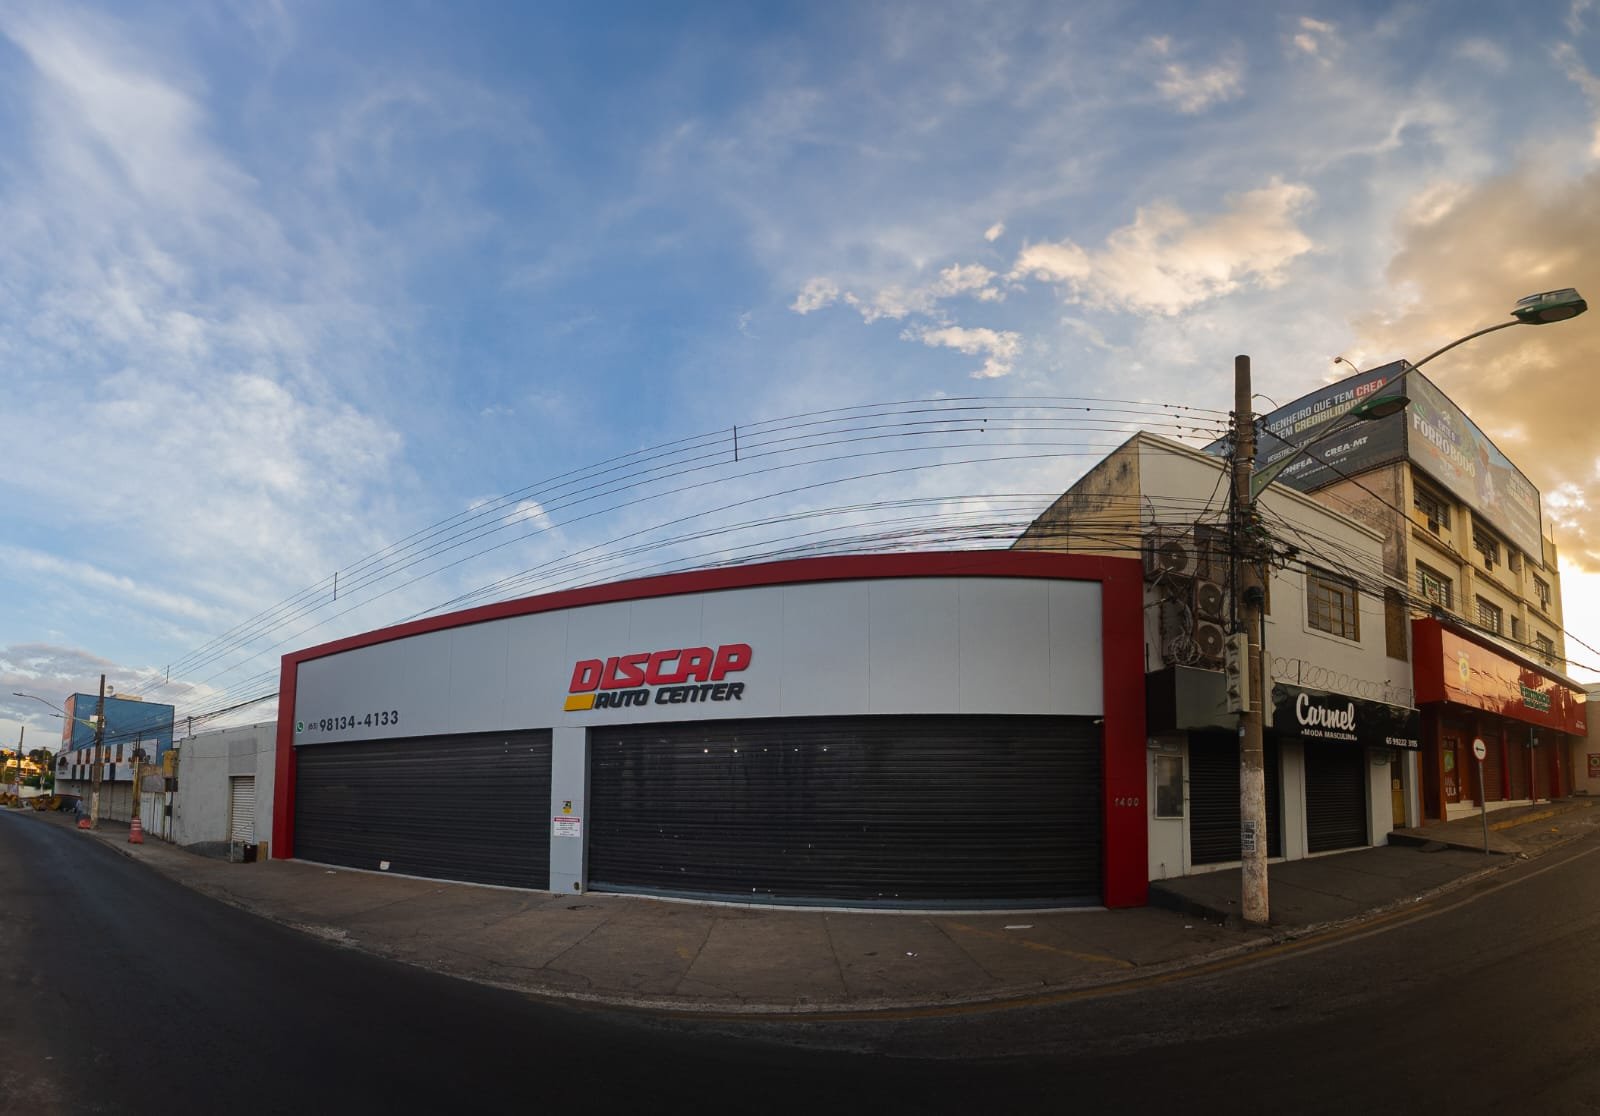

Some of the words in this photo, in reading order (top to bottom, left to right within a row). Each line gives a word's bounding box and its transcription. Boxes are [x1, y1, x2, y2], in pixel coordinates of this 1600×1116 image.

[1313, 398, 1332, 413] QUE
[1334, 389, 1355, 405] TEM
[1356, 379, 1383, 397] CREA
[1278, 457, 1313, 478] ONFEA
[1324, 436, 1369, 458] CREA-MT
[569, 643, 753, 693] DISCAP
[594, 689, 650, 710] AUTO
[655, 682, 745, 705] CENTER
[319, 710, 399, 732] 98134-4133
[1296, 693, 1356, 731] Carmel
[1304, 728, 1323, 737] MODA
[1114, 796, 1139, 808] 1400
